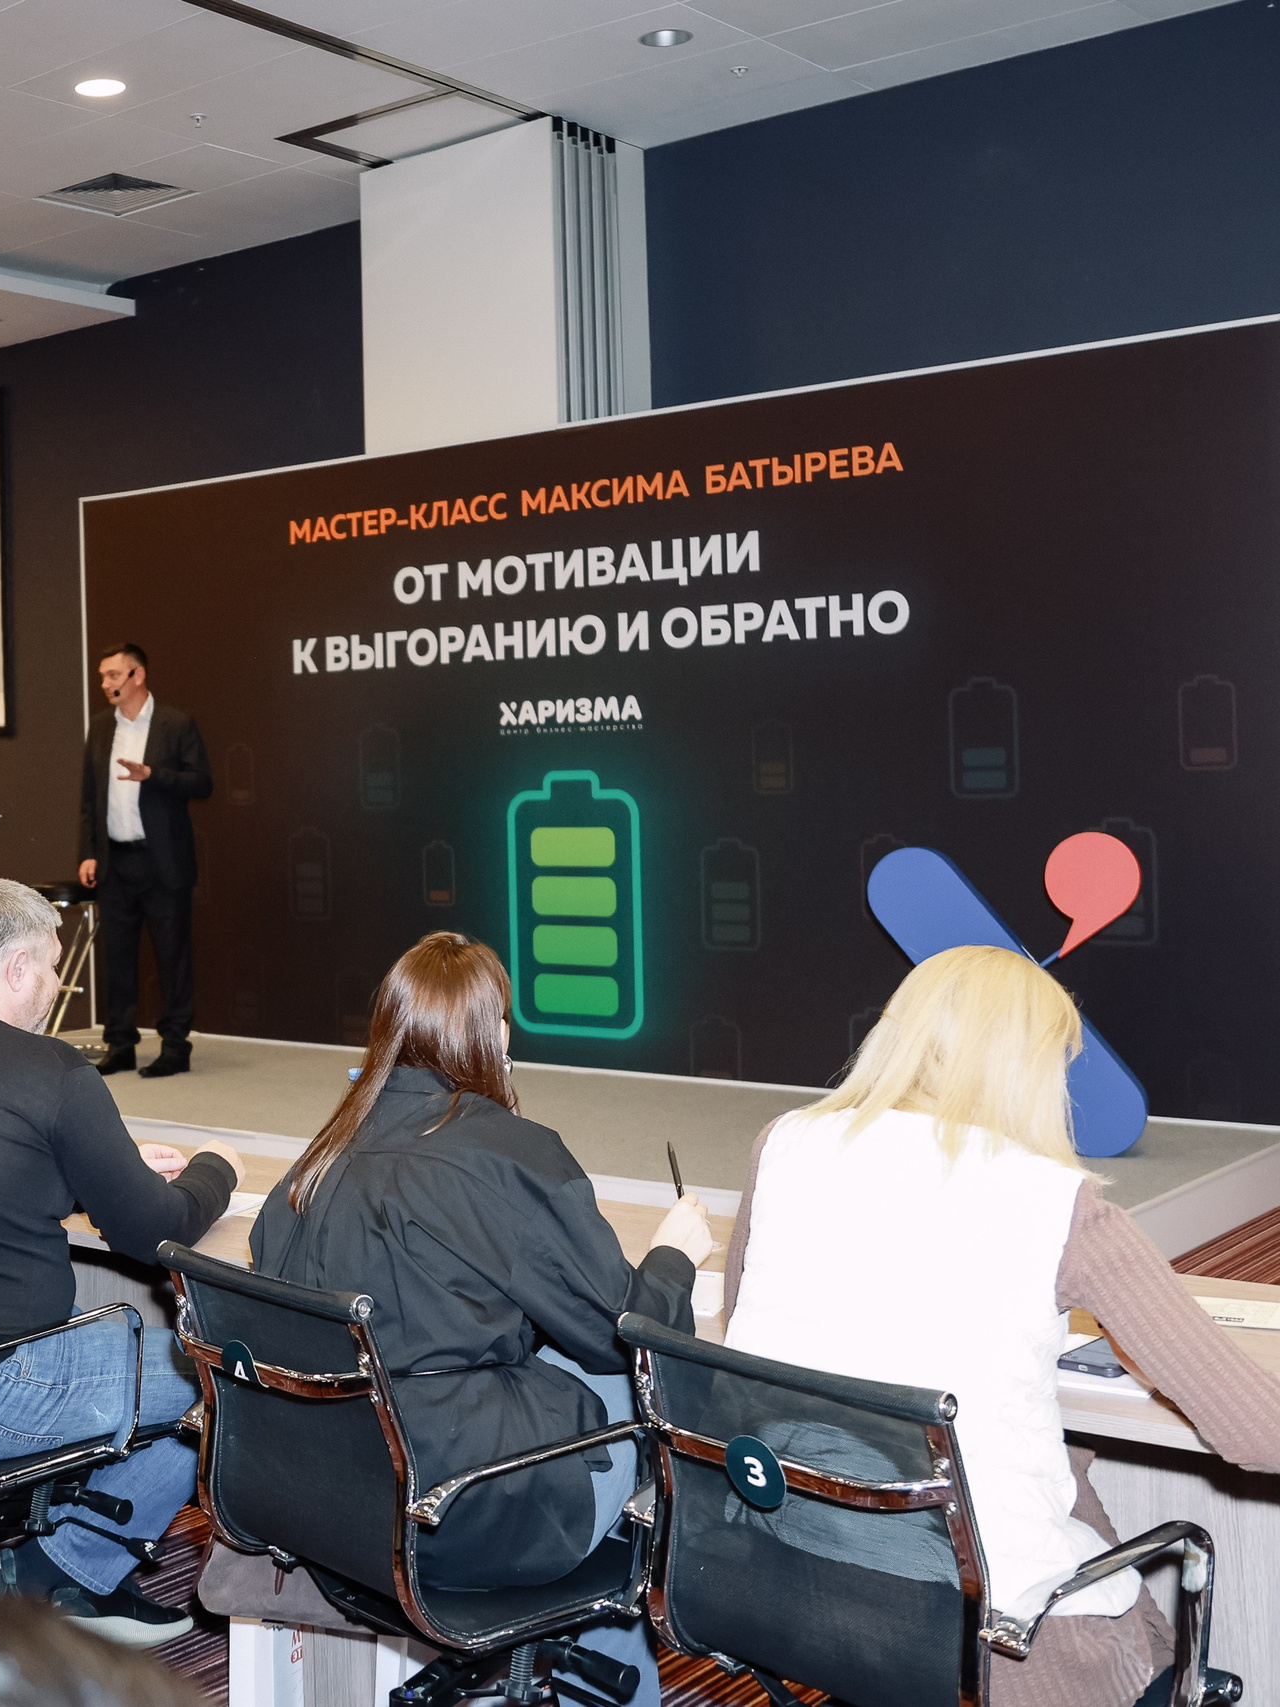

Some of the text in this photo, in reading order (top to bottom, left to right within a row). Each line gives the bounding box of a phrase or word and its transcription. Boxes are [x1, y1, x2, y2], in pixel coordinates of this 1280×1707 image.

[288, 441, 904, 545] МАСТЕР-КЛАСС МАКСИМА БАТЫРЕВА
[393, 530, 761, 605] ОТ МОТИВАЦИИ
[292, 589, 911, 675] К ВЫГОРАНИЮ И ОБРАТНО
[499, 694, 643, 727] ХАРИЗМА
[743, 1456, 767, 1487] 3
